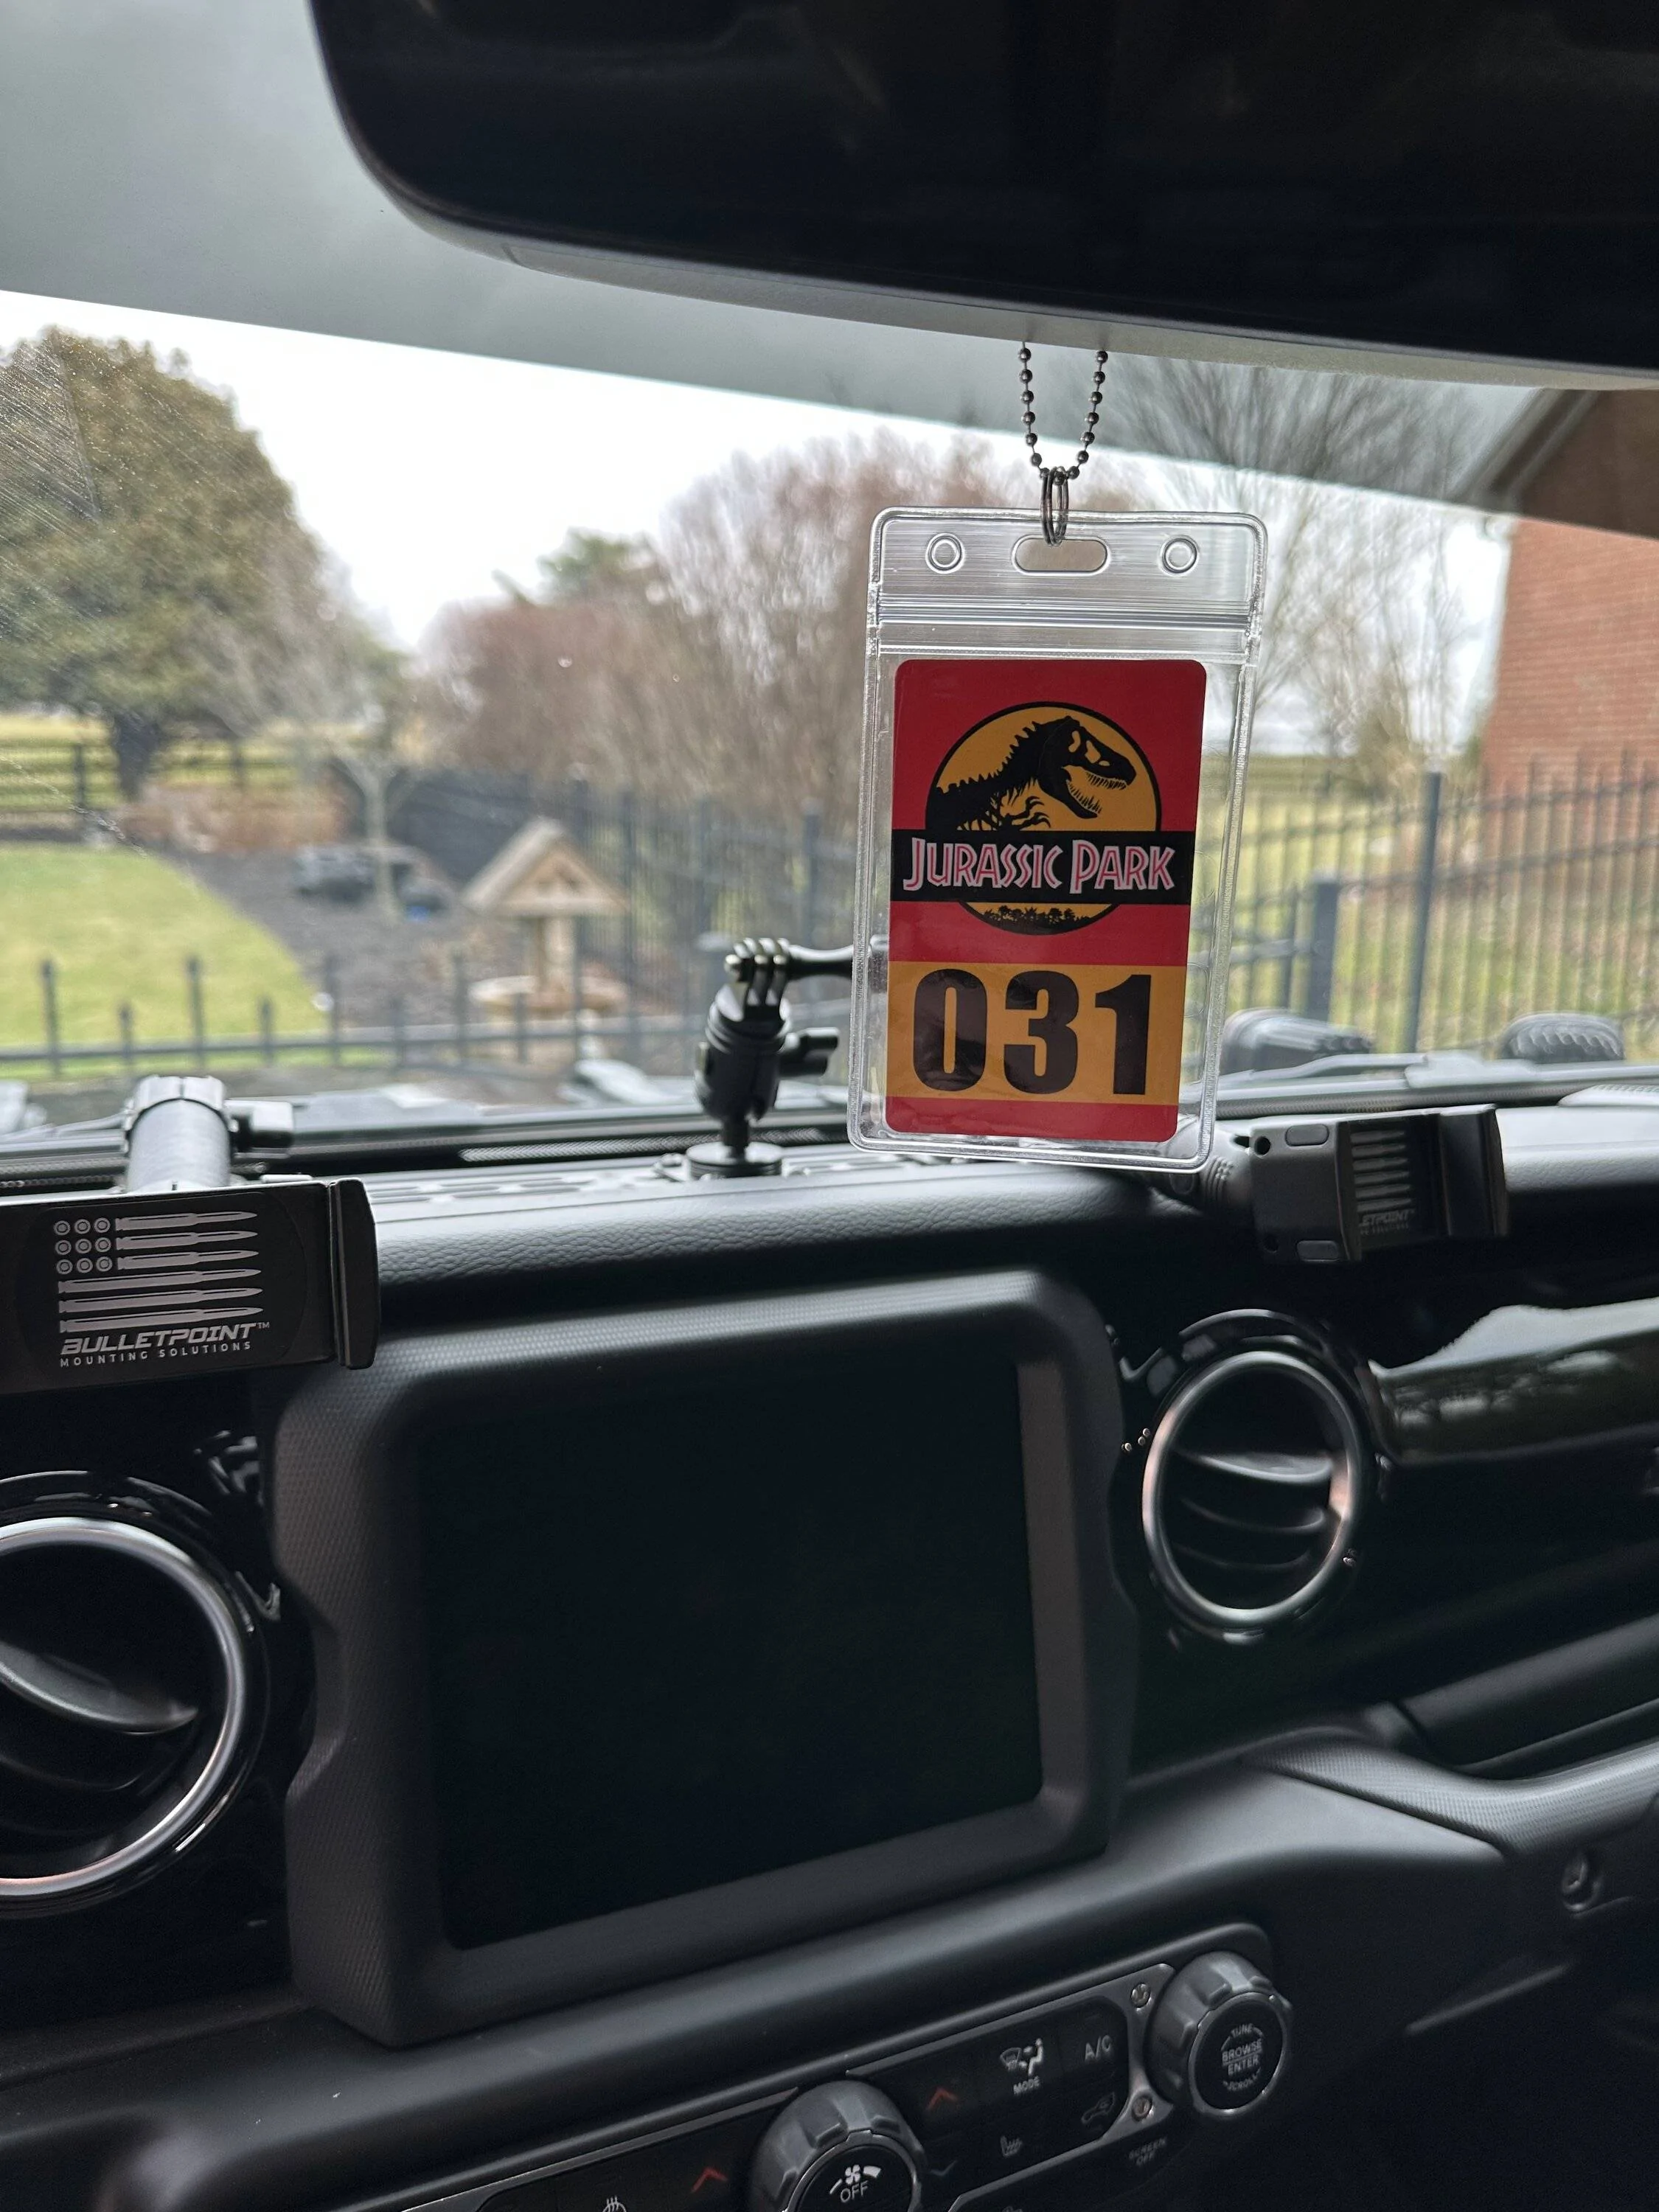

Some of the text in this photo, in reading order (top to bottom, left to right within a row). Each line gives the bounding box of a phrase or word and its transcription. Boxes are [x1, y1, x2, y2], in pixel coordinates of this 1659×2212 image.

[903, 838, 1175, 894] JURASSIC PARK
[913, 969, 1152, 1095] 031
[60, 1341, 251, 1368] MOUNTING SOLUTIONS
[1085, 2034, 1112, 2062] A/C
[1222, 2038, 1262, 2061] BROWSE
[1228, 2054, 1259, 2076] ENTER
[1013, 2076, 1040, 2095] MODE
[840, 2180, 869, 2202] OFF
